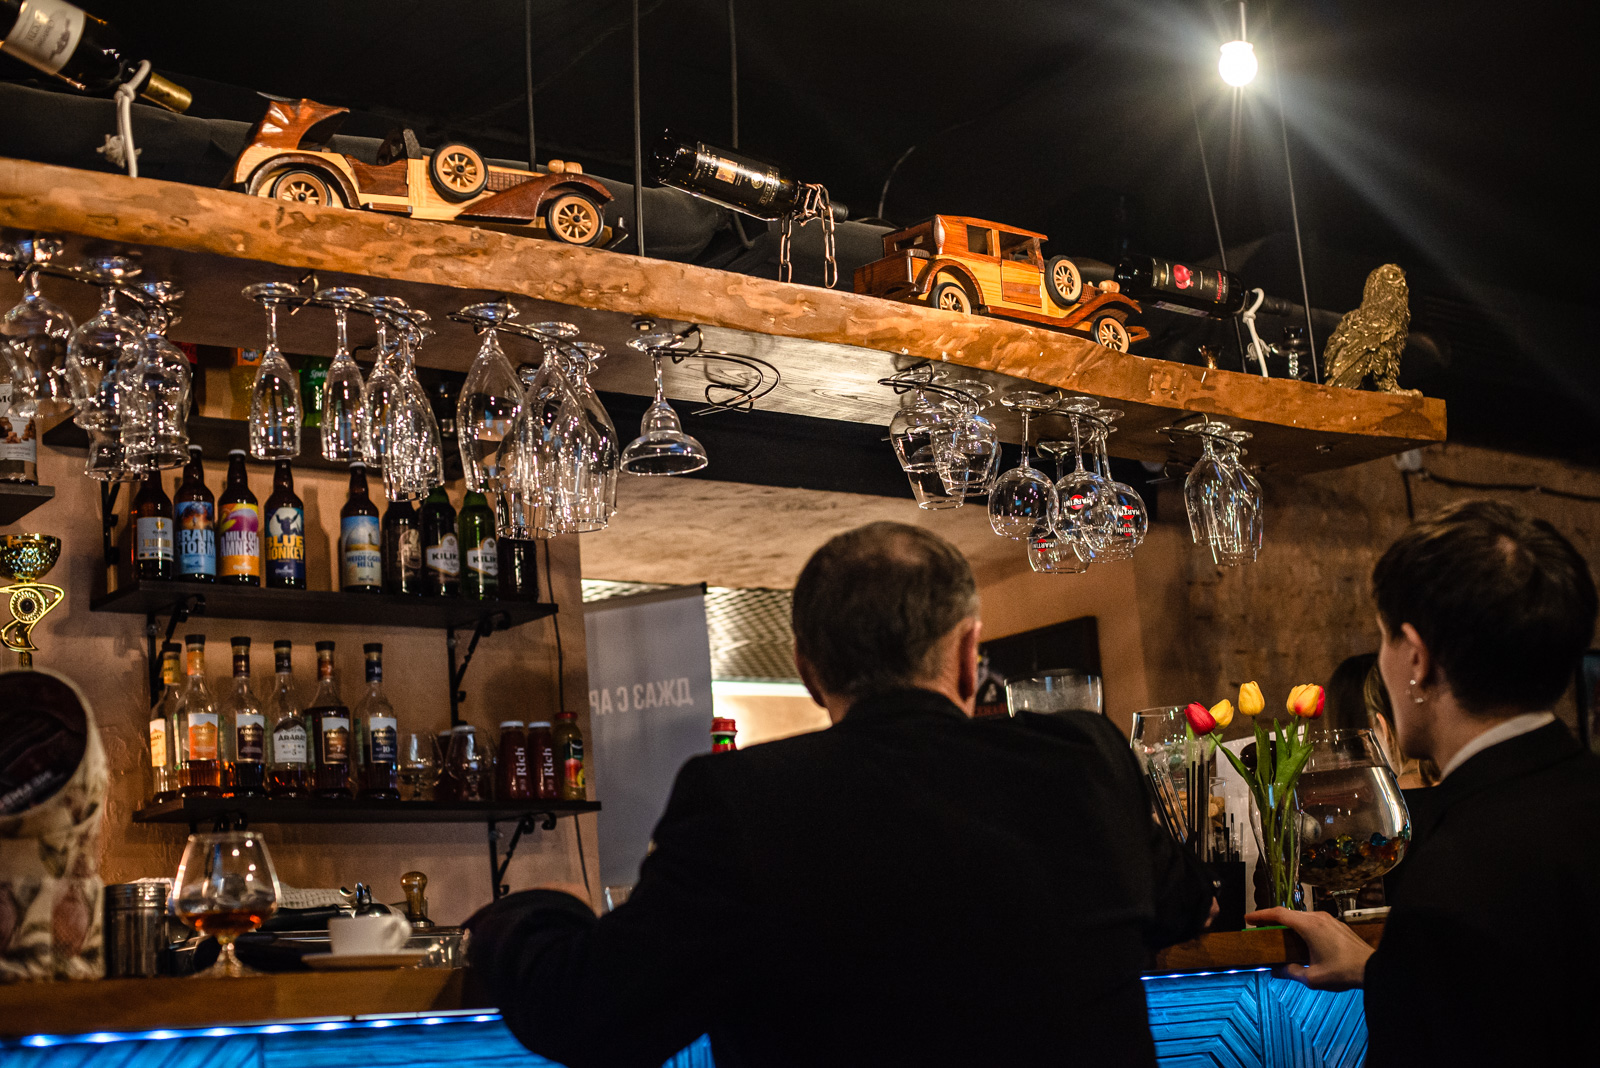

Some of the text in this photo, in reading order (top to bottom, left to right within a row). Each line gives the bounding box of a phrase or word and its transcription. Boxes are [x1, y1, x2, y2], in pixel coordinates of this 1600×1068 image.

[266, 534, 304, 547] BLUE
[515, 747, 527, 777] Rich
[542, 747, 555, 777] Rich
